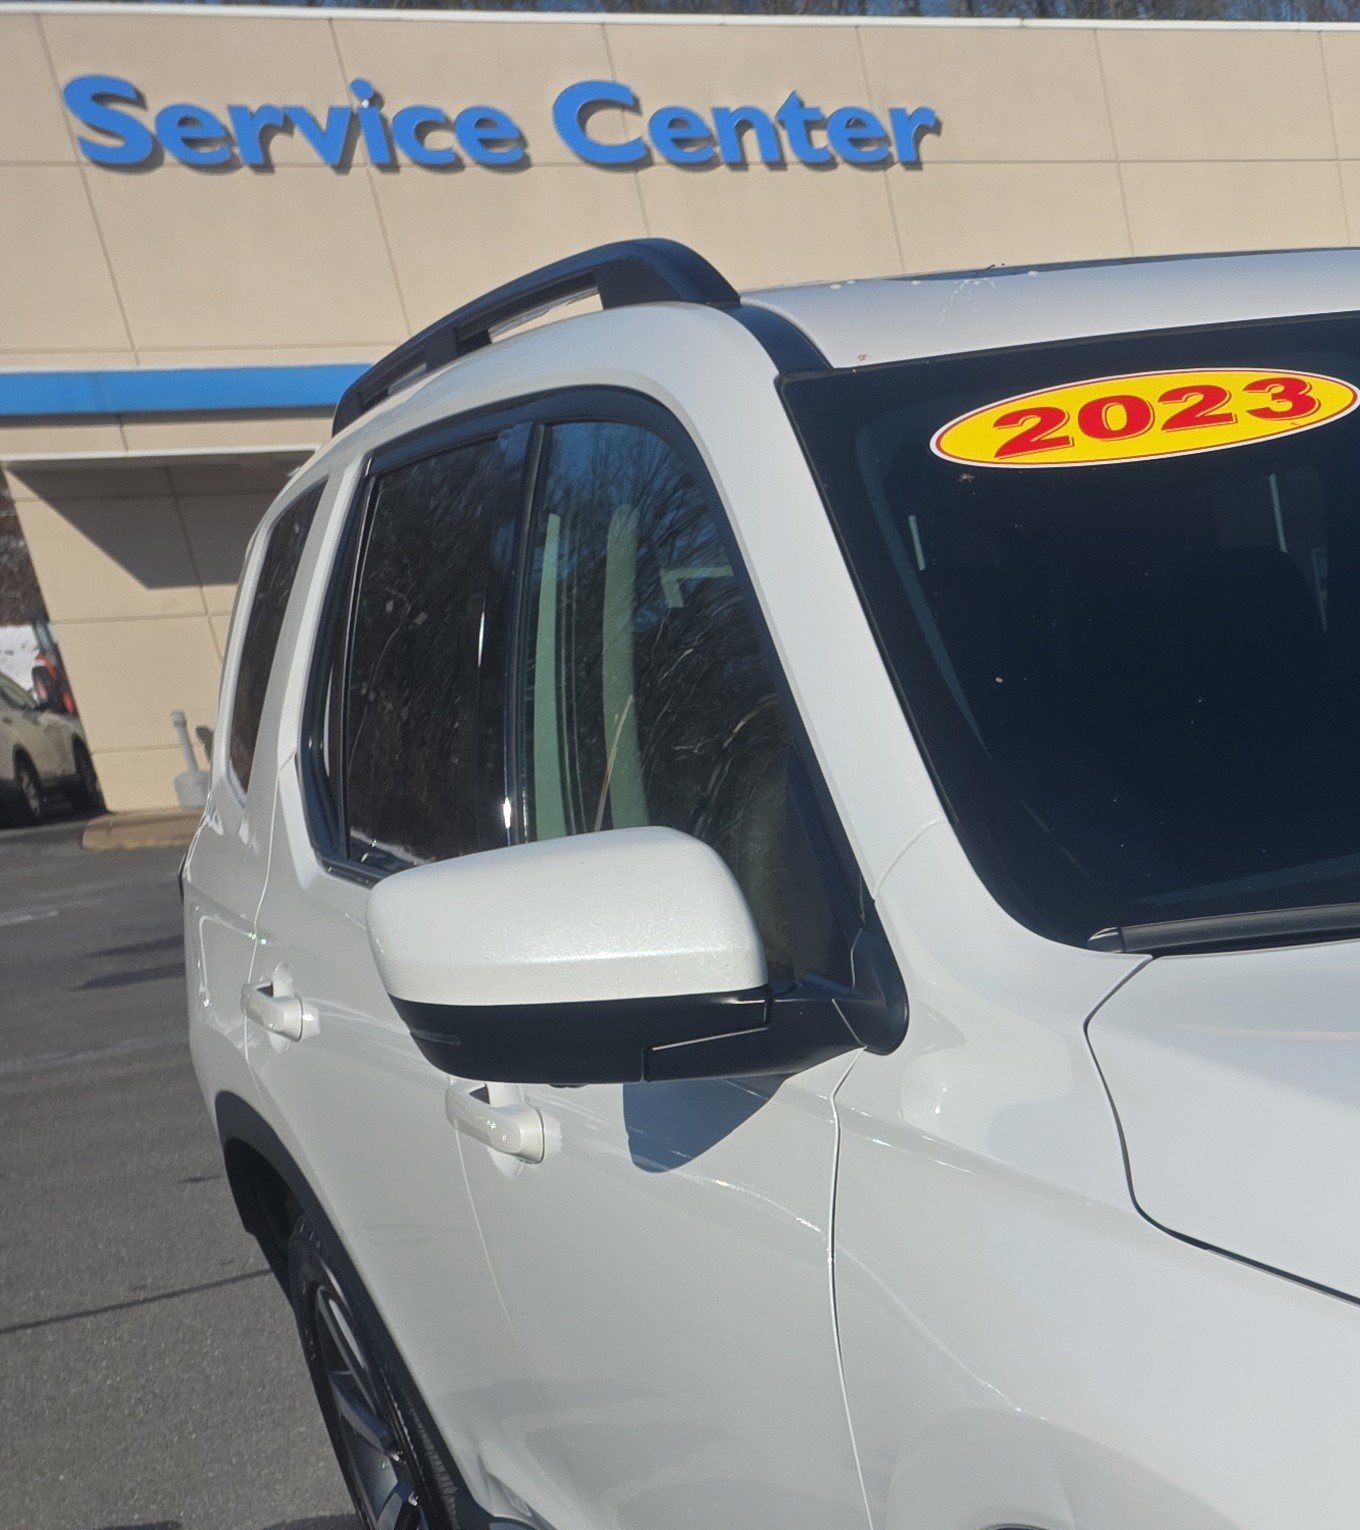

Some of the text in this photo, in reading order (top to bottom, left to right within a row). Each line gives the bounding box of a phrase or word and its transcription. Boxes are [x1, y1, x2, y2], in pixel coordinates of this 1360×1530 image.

[62, 74, 938, 169] Service Center
[993, 376, 1322, 460] 2023
